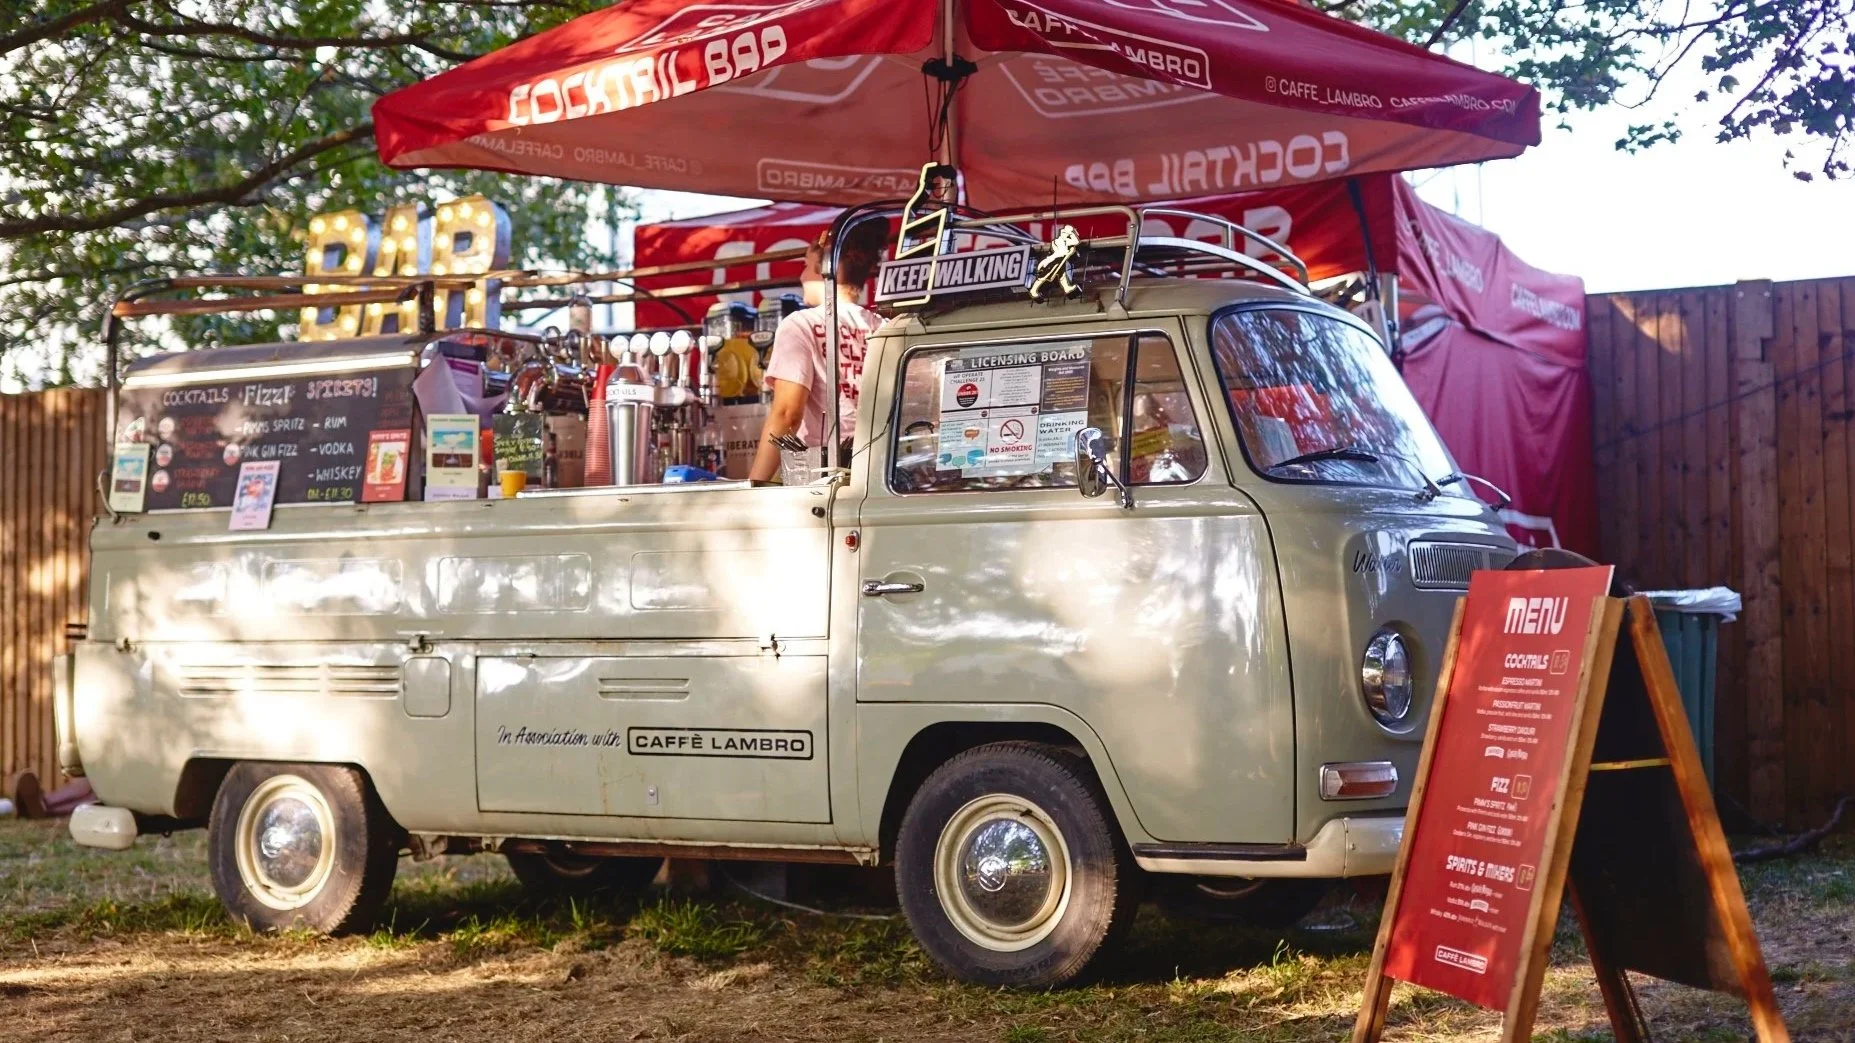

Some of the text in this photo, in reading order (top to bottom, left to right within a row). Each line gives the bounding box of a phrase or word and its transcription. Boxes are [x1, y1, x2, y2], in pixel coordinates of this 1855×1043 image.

[508, 51, 697, 126] COCKTAIL
[704, 25, 788, 87] BAR
[298, 193, 512, 342] BAR
[883, 264, 932, 294] KEEP
[934, 252, 1022, 288] WALKING
[971, 349, 1085, 368] LICENSING BOARD
[163, 387, 229, 407] COCKTAILS
[1039, 419, 1085, 429] DRINKING
[1001, 444, 1033, 453] SMOKING
[1503, 596, 1569, 635] MENU
[1504, 653, 1550, 670] COCKTAILS
[514, 725, 588, 747] Association
[593, 728, 621, 748] with
[635, 733, 703, 749] CAFFÈ
[712, 737, 806, 752] LAMBRO
[1490, 776, 1511, 794] FIZZ
[1446, 854, 1478, 875] SPIRITS
[1477, 861, 1485, 877] &
[1485, 862, 1516, 883] MIXERS
